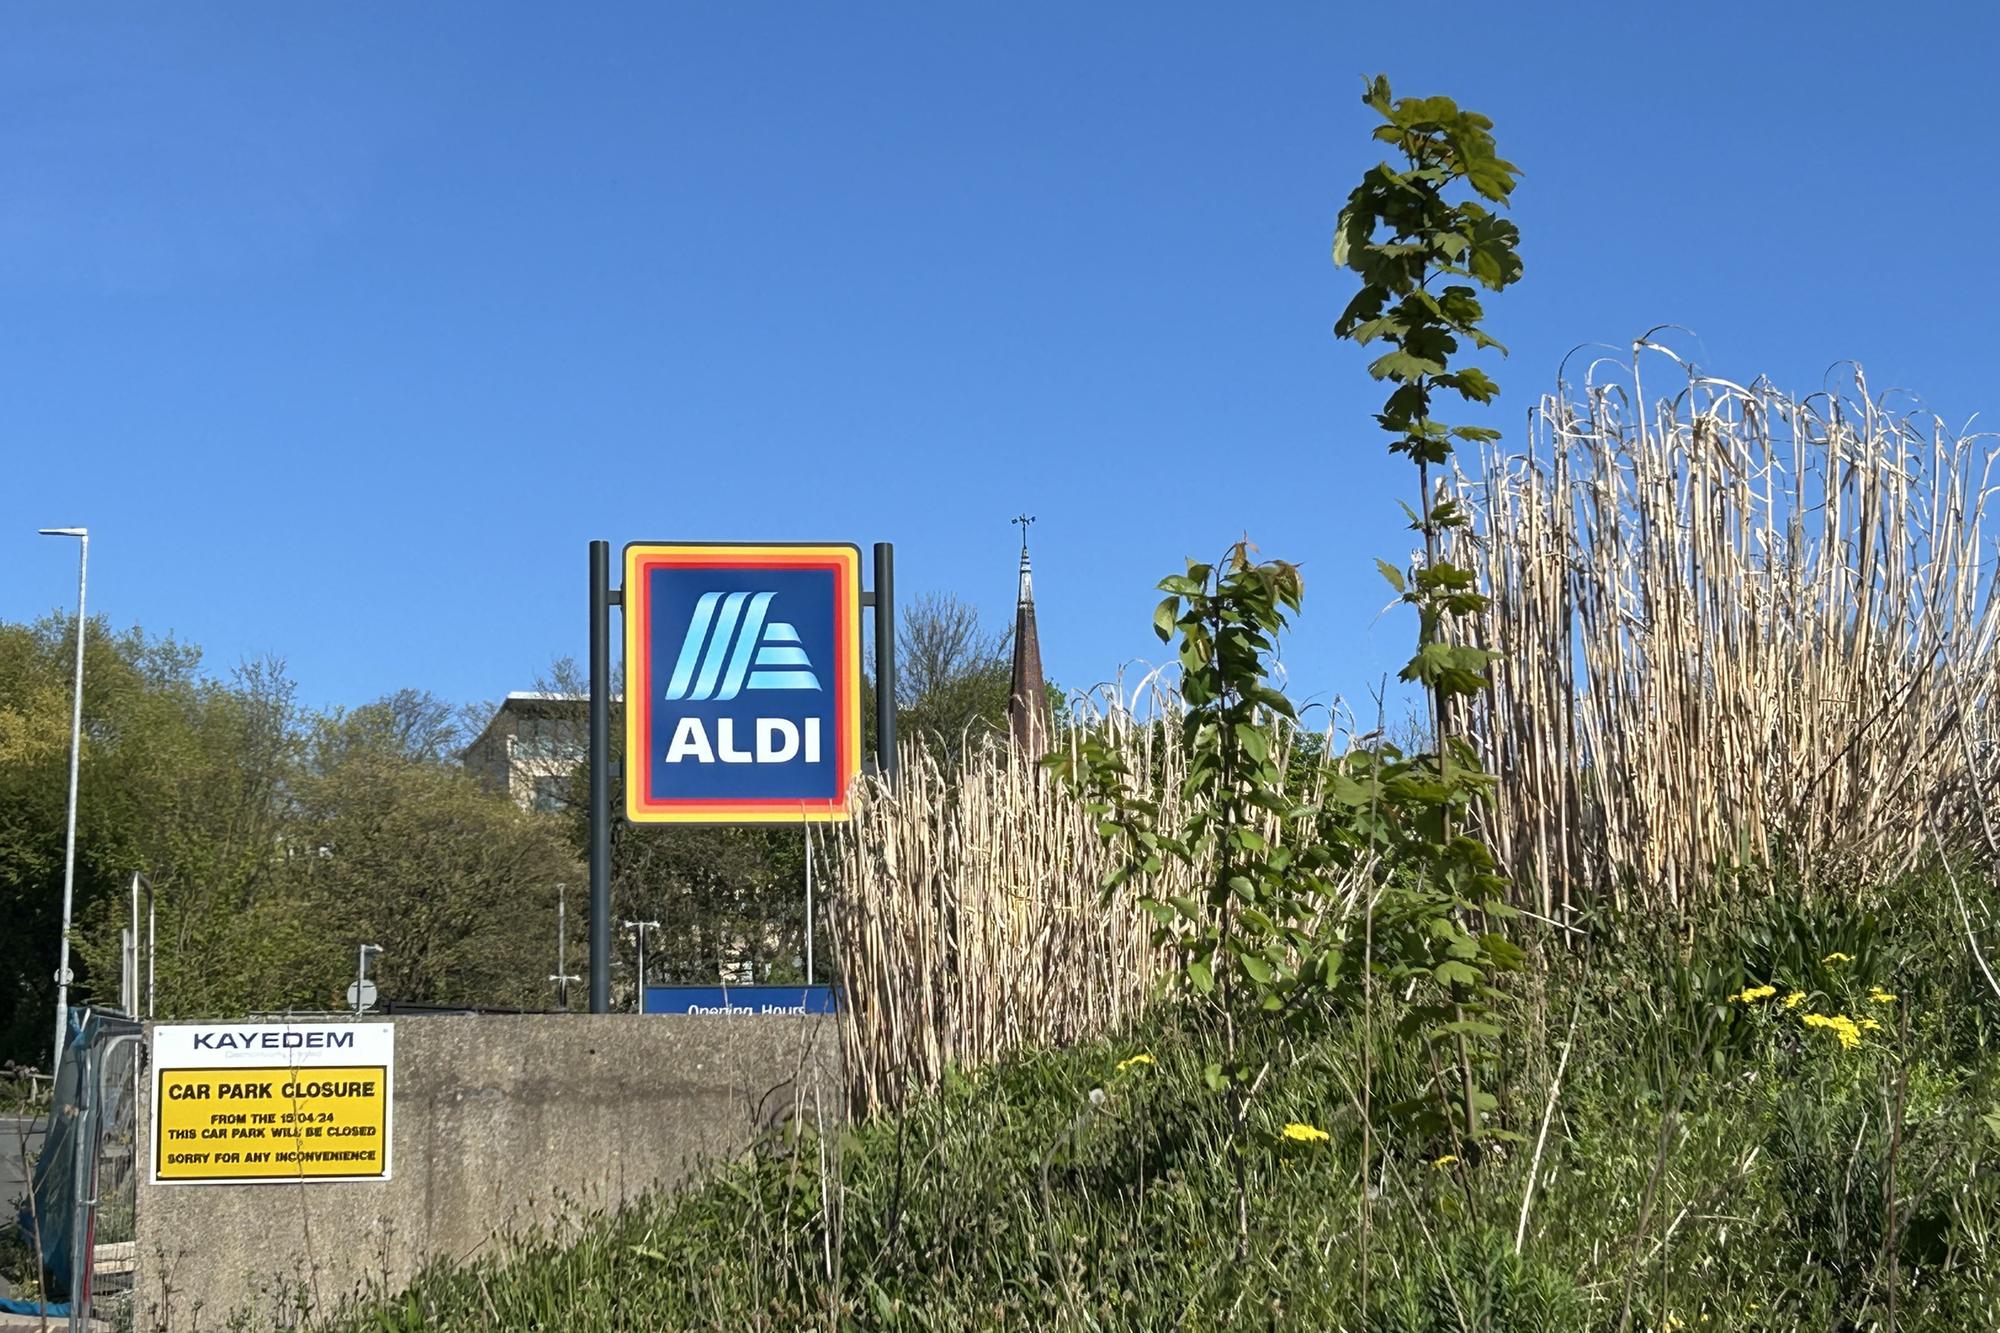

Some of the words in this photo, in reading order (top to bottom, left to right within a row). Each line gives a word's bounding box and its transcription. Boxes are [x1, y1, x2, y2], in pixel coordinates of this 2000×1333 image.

[665, 717, 821, 763] ALDI
[194, 1031, 354, 1049] KAYEDEM
[168, 1083, 211, 1100] CAR
[218, 1082, 273, 1099] PARK
[281, 1081, 376, 1098] CLOSURE
[210, 1114, 246, 1125] FROM
[251, 1113, 276, 1124] THE
[168, 1129, 197, 1139] THIS
[201, 1128, 227, 1139] CAR
[232, 1128, 265, 1138] PARK
[271, 1127, 302, 1138] WILL
[305, 1127, 322, 1137] BE
[326, 1126, 377, 1137] CLOSED
[167, 1153, 210, 1164] SORRY
[214, 1153, 240, 1164] FOR
[244, 1152, 271, 1163] ANY
[275, 1150, 376, 1163] INCONVENIENCE
